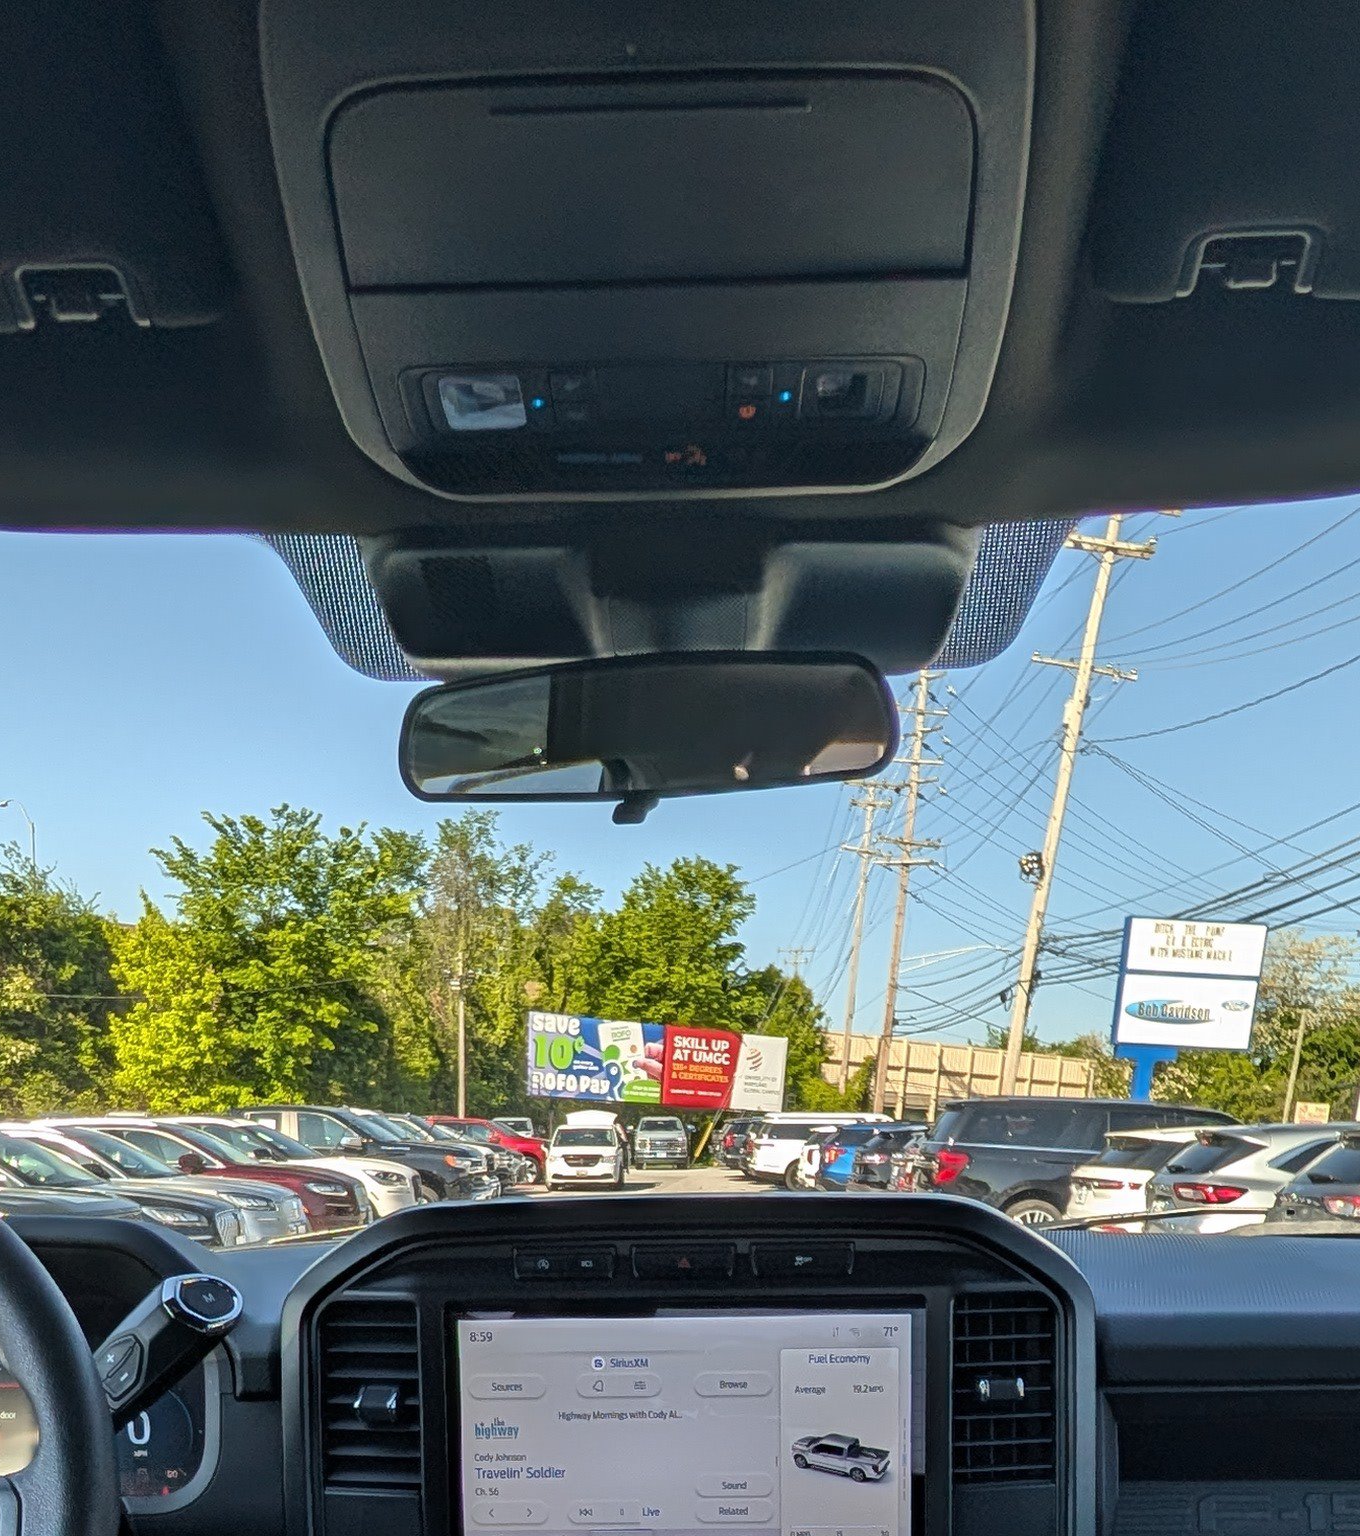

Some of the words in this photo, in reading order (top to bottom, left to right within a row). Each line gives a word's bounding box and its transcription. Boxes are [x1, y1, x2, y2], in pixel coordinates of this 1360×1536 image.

[1138, 1001, 1159, 1017] Bob
[1160, 1003, 1211, 1020] Davidson
[673, 1035, 709, 1050] SKILL
[711, 1038, 730, 1052] UP
[672, 1049, 691, 1061] AT
[692, 1051, 731, 1065] UMGC
[689, 1063, 723, 1074] DEGREES
[202, 1292, 217, 1304] M
[469, 1331, 493, 1343] 8:59
[883, 1326, 899, 1338] 71°
[609, 1358, 649, 1369] SiriusXM
[808, 1354, 828, 1365] Fuel
[829, 1354, 871, 1366] Economy
[492, 1382, 523, 1393] Sources
[719, 1380, 748, 1390] Browse
[794, 1385, 826, 1396] Average
[0, 1410, 17, 1420] door
[558, 1411, 591, 1422] Highway
[592, 1410, 628, 1422] Mornings
[629, 1410, 647, 1420] with
[648, 1410, 668, 1421] Cody
[474, 1422, 520, 1440] highway
[474, 1453, 493, 1463] Cody
[495, 1453, 527, 1462] Johnson
[475, 1467, 524, 1480] Travelin'
[526, 1466, 567, 1480] Soldier
[721, 1480, 748, 1490] Sound
[475, 1487, 487, 1497] Ch.
[642, 1507, 661, 1517] Live
[718, 1506, 749, 1516] Related
